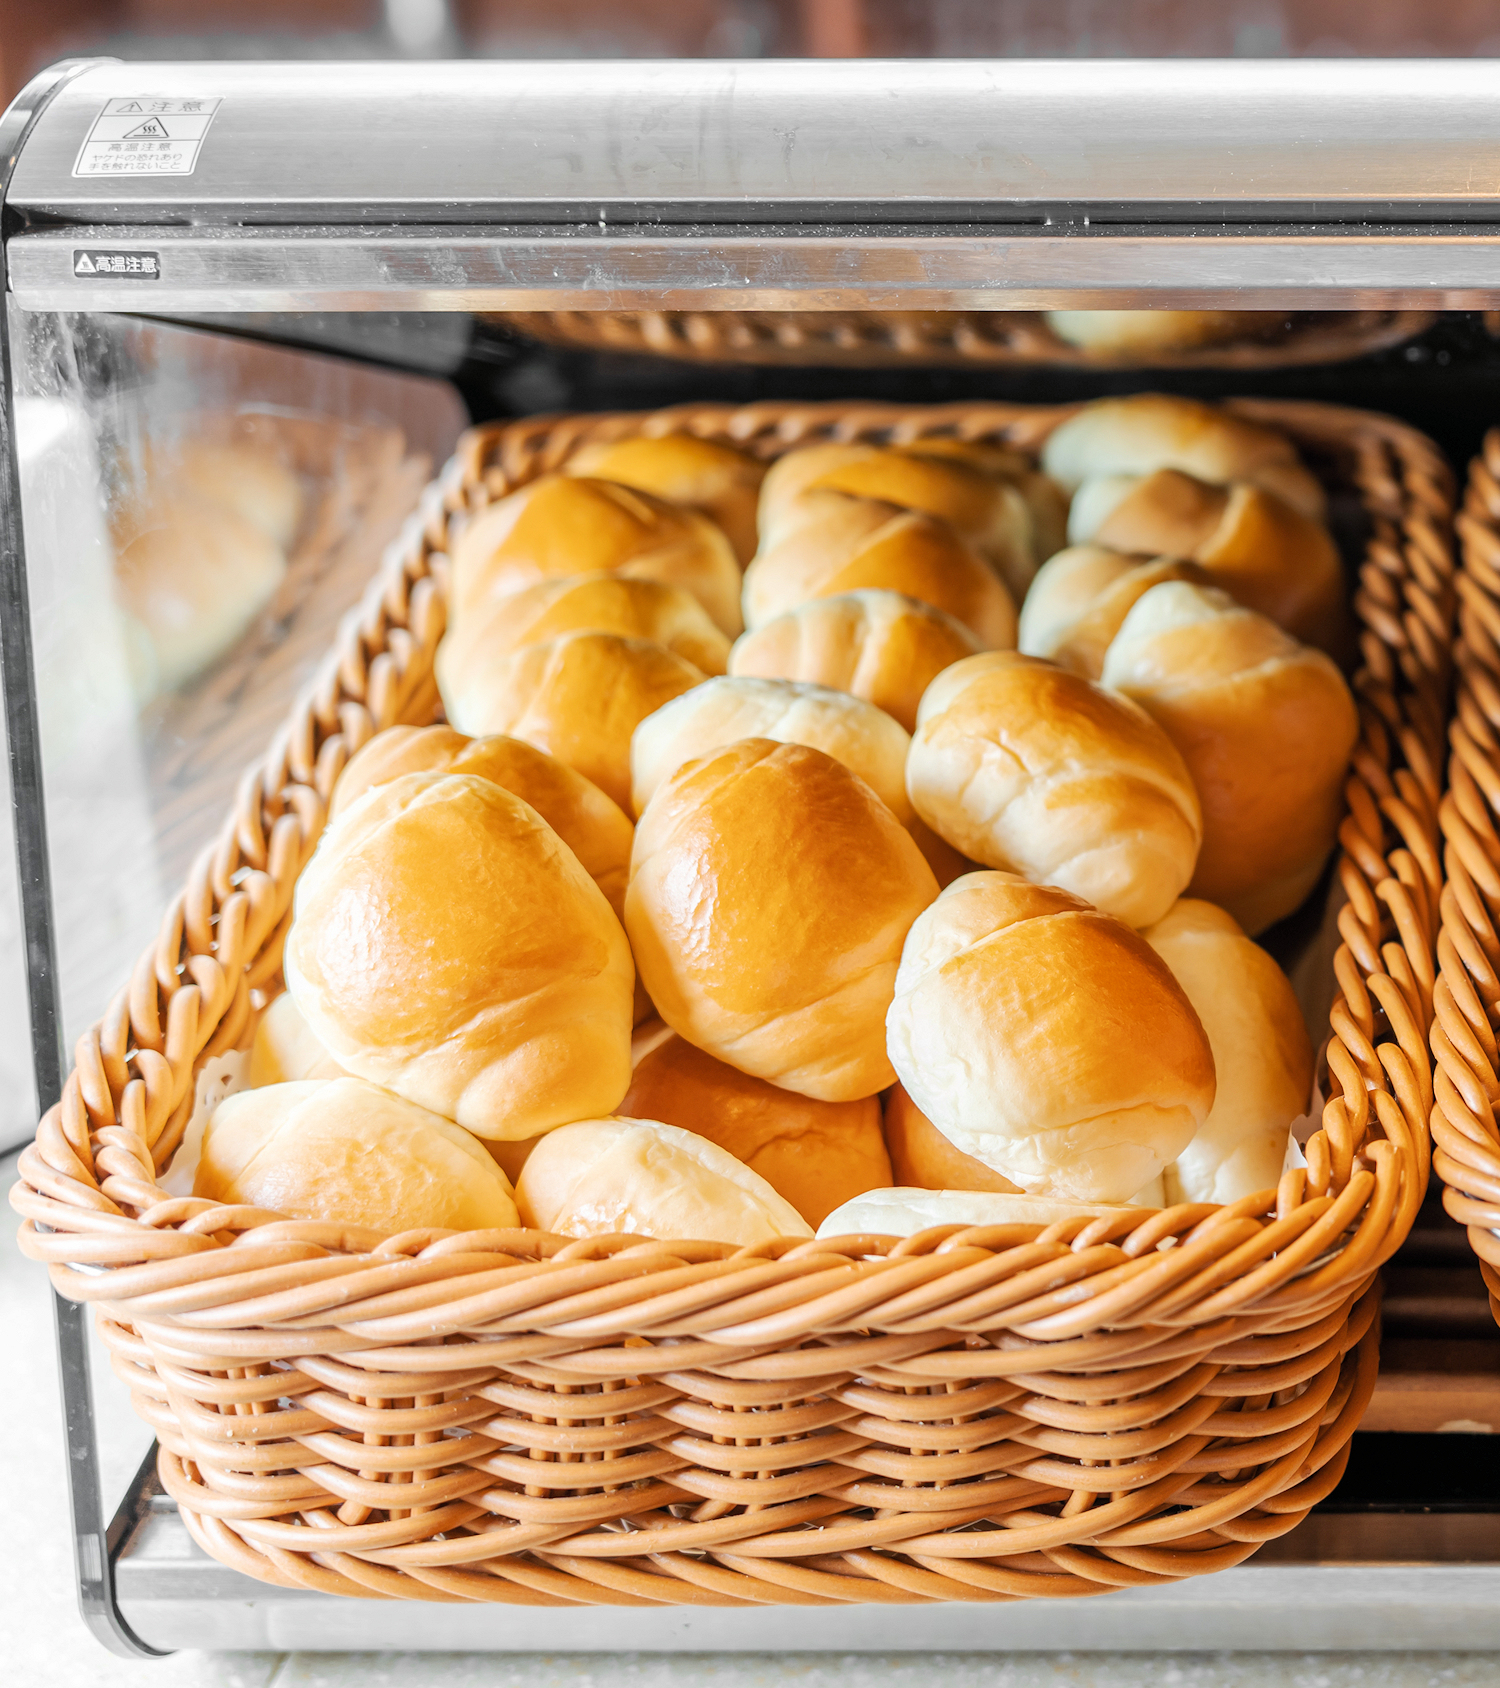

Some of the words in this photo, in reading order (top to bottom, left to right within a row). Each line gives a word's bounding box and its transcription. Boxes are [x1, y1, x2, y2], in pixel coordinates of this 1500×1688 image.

[147, 101, 206, 113] 注意
[107, 142, 173, 152] 高温注意
[95, 255, 157, 273] 高温注意
